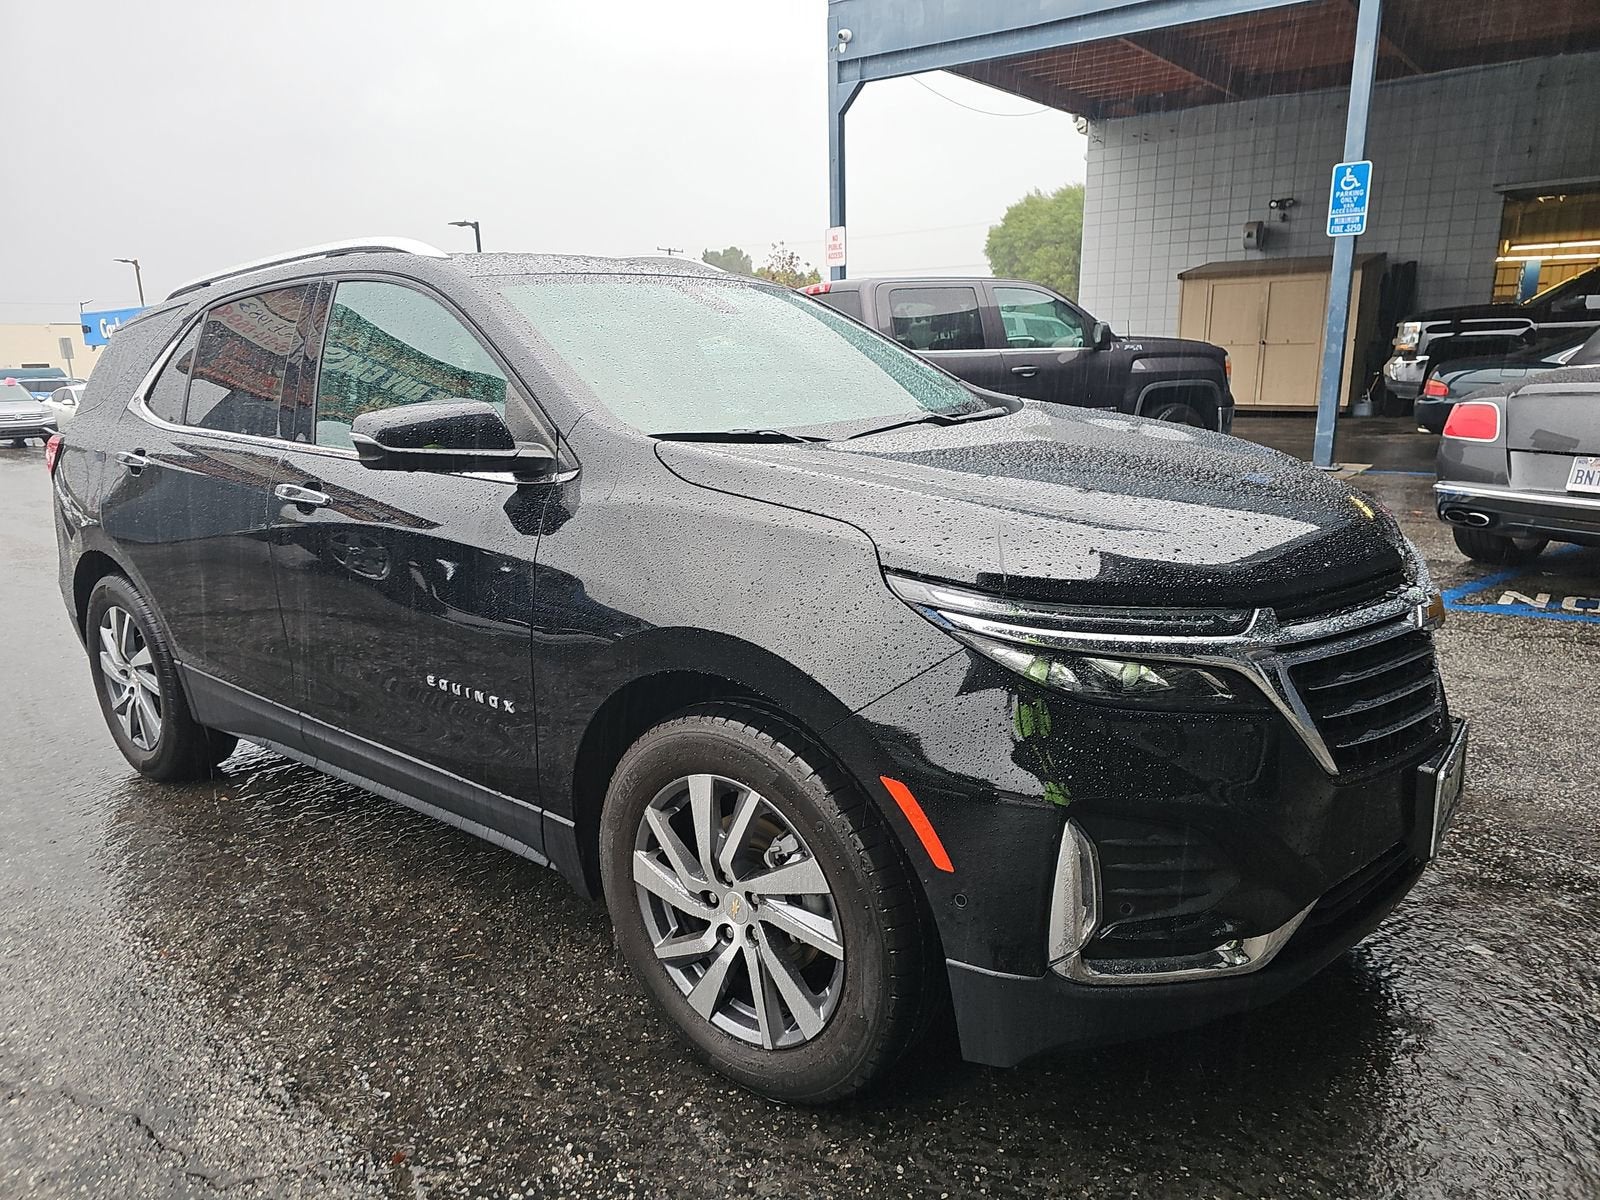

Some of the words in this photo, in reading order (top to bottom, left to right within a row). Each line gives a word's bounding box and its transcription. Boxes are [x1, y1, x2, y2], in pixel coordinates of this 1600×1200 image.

[1335, 189, 1365, 198] PARKING
[1340, 196, 1358, 204] ONLY
[1334, 216, 1361, 224] MINIMUM
[1331, 225, 1344, 233] FINE
[828, 243, 843, 251] PUBLIC
[828, 251, 844, 259] ACCESS
[426, 675, 515, 713] EQUINOX
